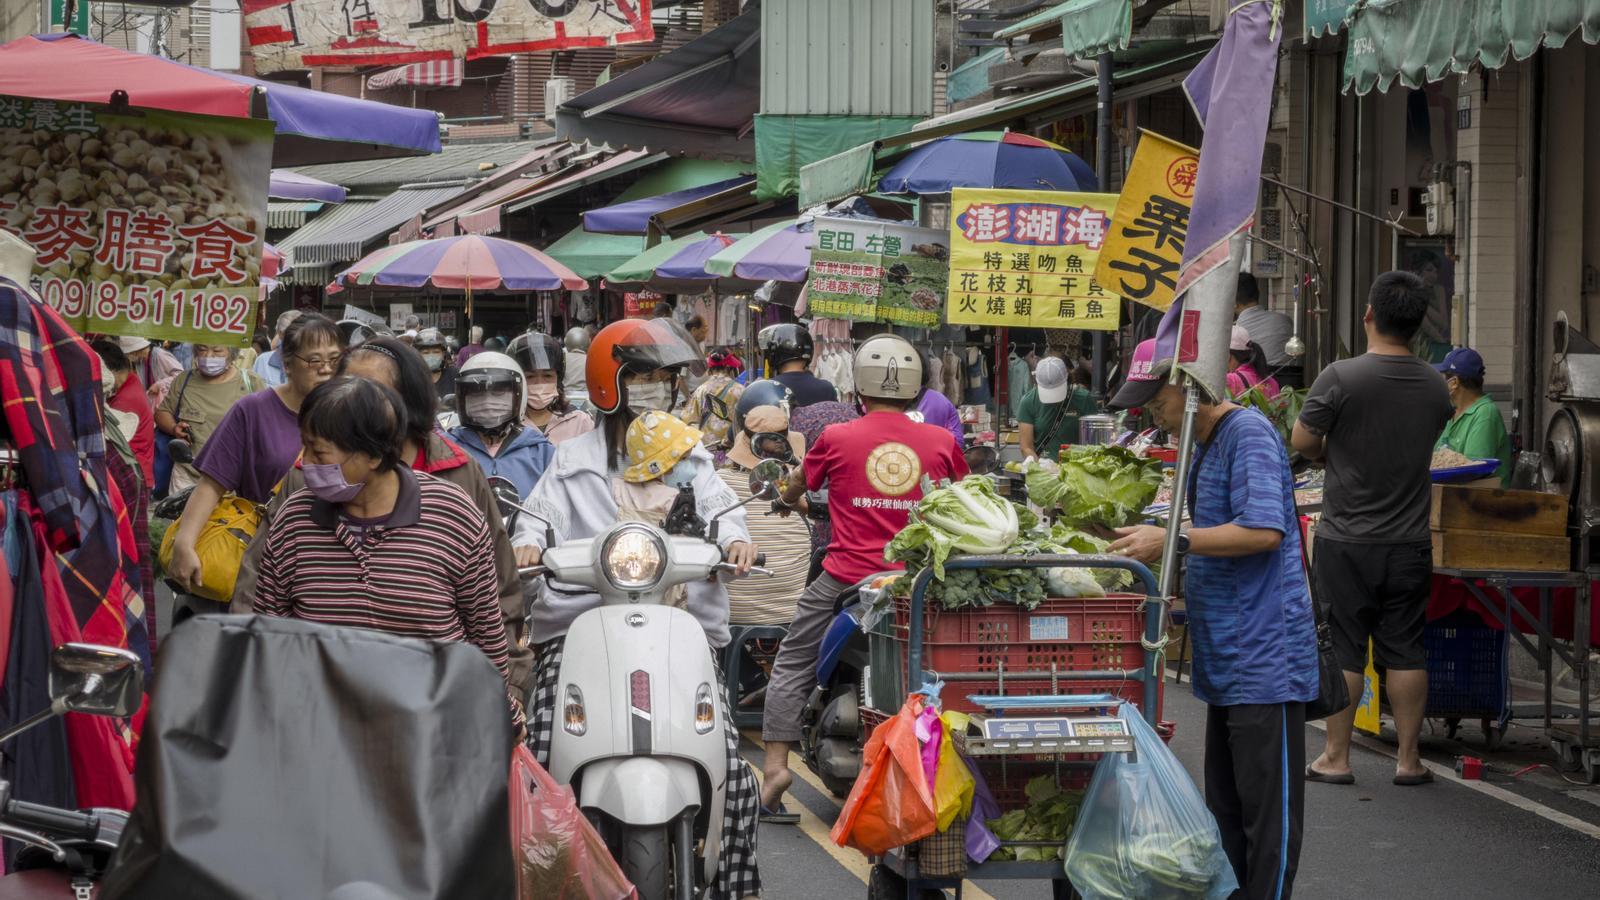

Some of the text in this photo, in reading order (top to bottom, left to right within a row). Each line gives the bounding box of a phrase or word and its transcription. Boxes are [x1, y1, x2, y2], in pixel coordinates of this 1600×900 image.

[963, 203, 1105, 250] 澎湖海
[0, 203, 256, 282] 麥膳食
[818, 229, 901, 257] 官田 左營
[1108, 194, 1191, 299] 栗子
[984, 251, 1084, 273] 特選吻魚
[813, 279, 883, 297] 北港蒸汽花生
[960, 272, 1033, 294] 花枝丸
[44, 277, 250, 333] 0918-511182
[959, 294, 1032, 316] 火燒蝦
[1058, 299, 1104, 319] 扁魚
